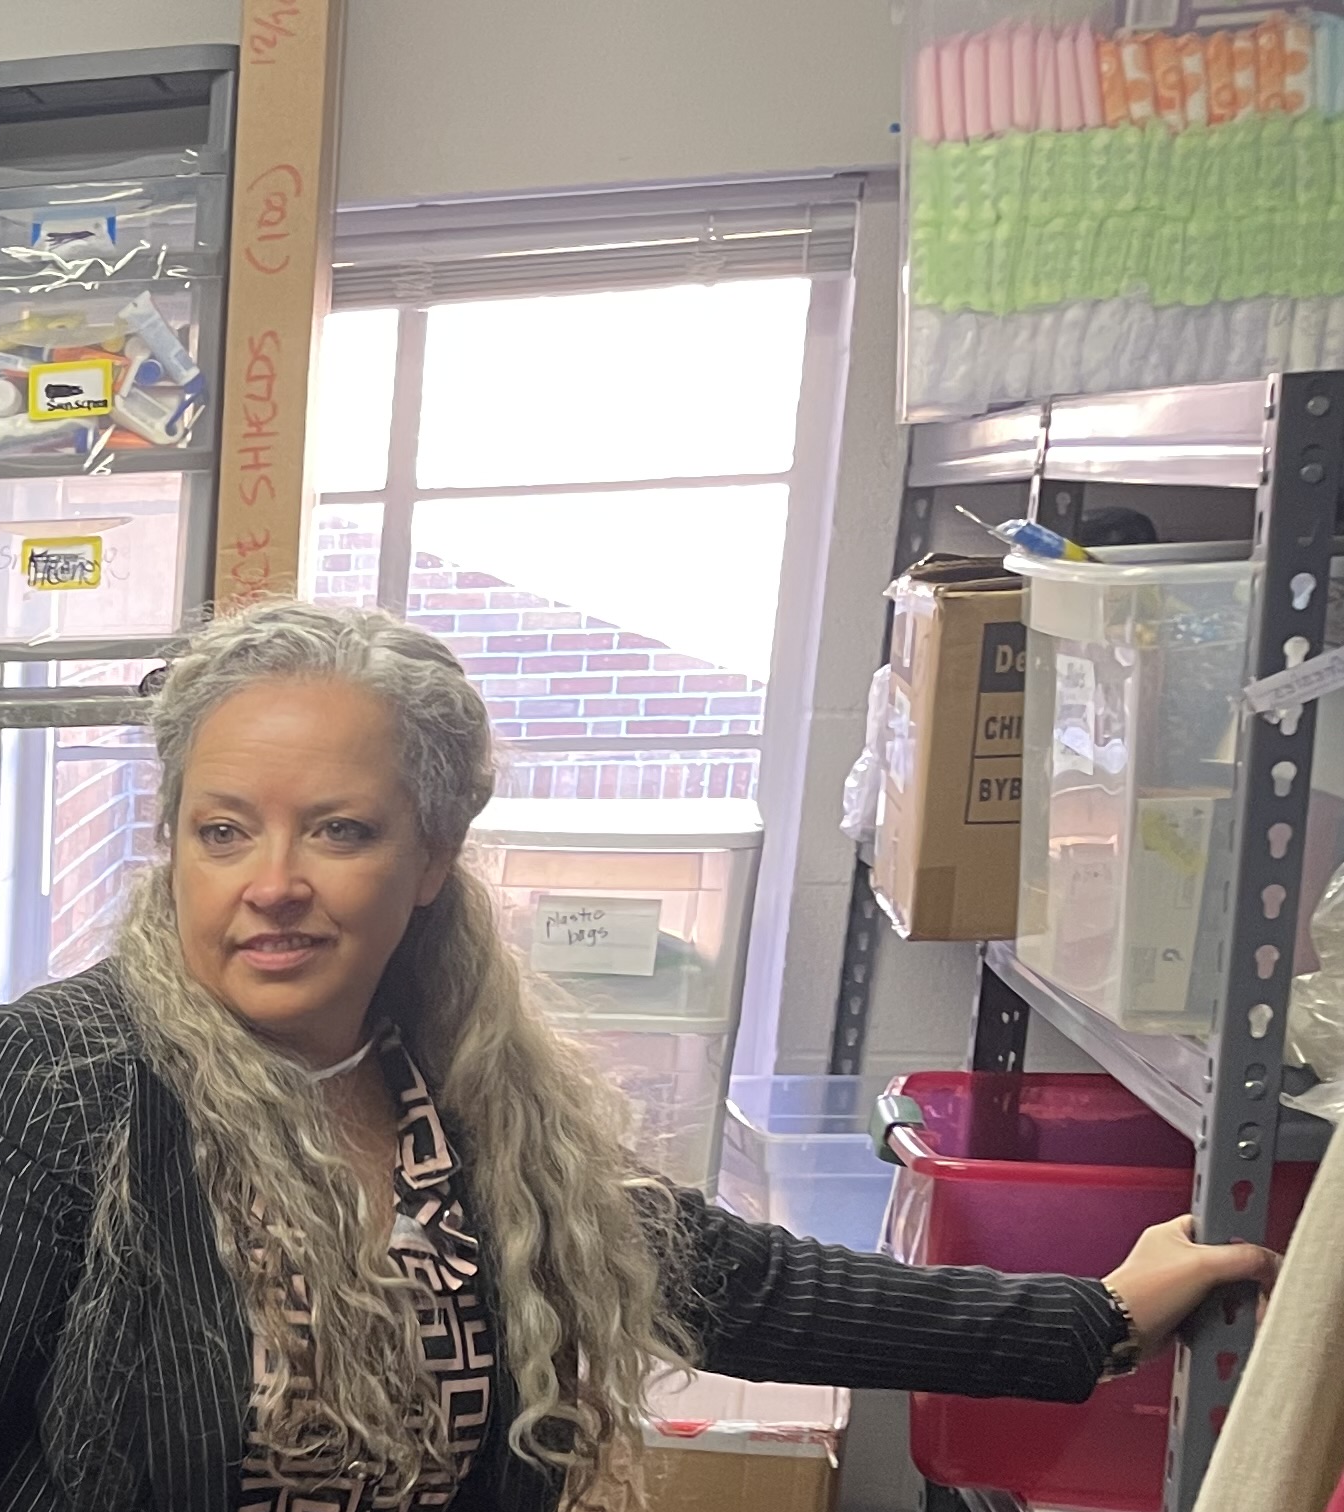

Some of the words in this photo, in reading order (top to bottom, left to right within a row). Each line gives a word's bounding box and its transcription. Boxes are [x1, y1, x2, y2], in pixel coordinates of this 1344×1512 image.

[245, 163, 303, 275] (100)
[238, 330, 281, 506] SHIELDS
[546, 908, 606, 939] plastic
[568, 926, 609, 947] bags
